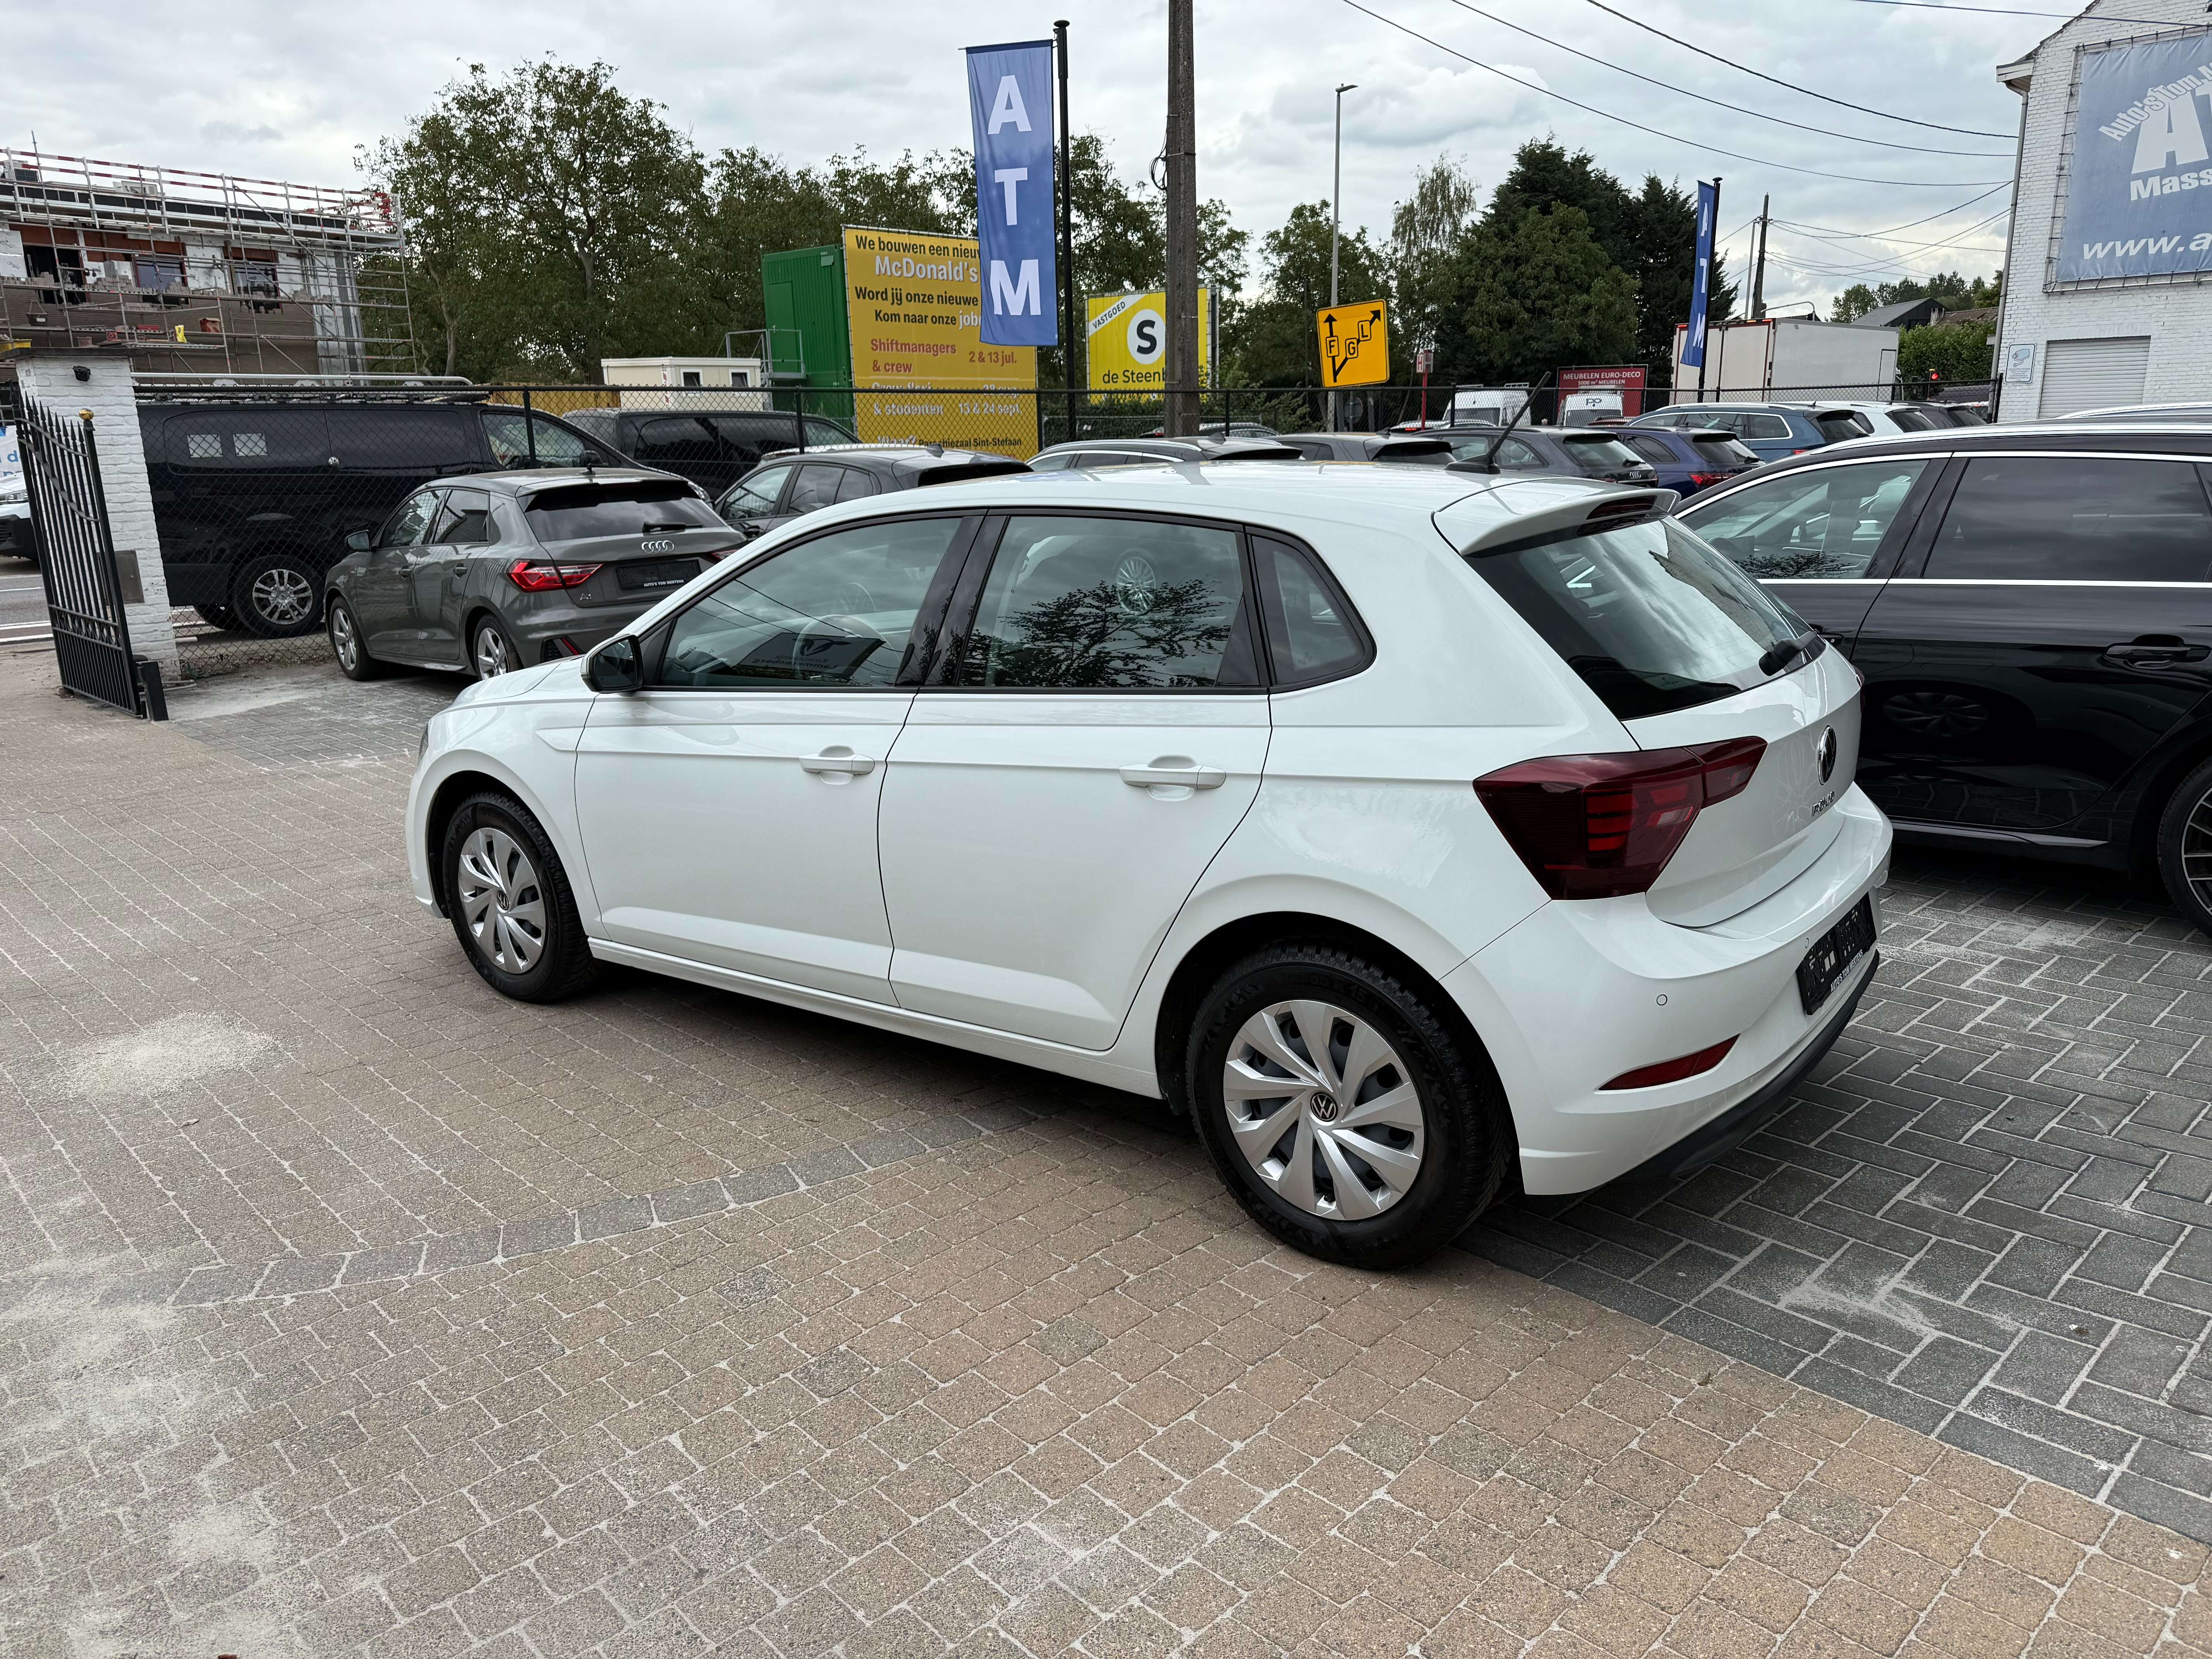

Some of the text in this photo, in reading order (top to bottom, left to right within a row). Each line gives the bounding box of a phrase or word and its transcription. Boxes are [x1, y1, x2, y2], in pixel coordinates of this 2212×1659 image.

[2098, 96, 2165, 141] Auto's
[2152, 74, 2204, 100] Tom
[988, 75, 1041, 316] ATM
[855, 235, 875, 250] We
[878, 237, 925, 254] bouwen
[929, 245, 949, 256] een
[2083, 233, 2212, 259] www.a
[875, 255, 978, 283] McDonald's
[855, 286, 978, 306] Word jij onze nieuwe
[875, 310, 900, 322] Kom
[904, 315, 928, 324] naar
[931, 315, 956, 325] onze
[1093, 302, 1125, 329] VASTGOED
[1137, 319, 1157, 355] S
[1361, 324, 1368, 338] L
[871, 338, 957, 357] Shiftmanagers
[1329, 340, 1336, 354] F
[1348, 342, 1356, 355] G
[872, 360, 912, 373] & crew
[969, 351, 1017, 366] 2 & 13 jul.
[1103, 369, 1118, 383] de
[885, 402, 944, 415] studenten
[983, 402, 995, 414] 24
[919, 438, 971, 447] Parhiezaal
[973, 437, 1022, 446] Sint-Stefaan
[1811, 791, 1834, 818] POLO
[1831, 949, 1863, 993] AUTO'S TOM MERTENS
